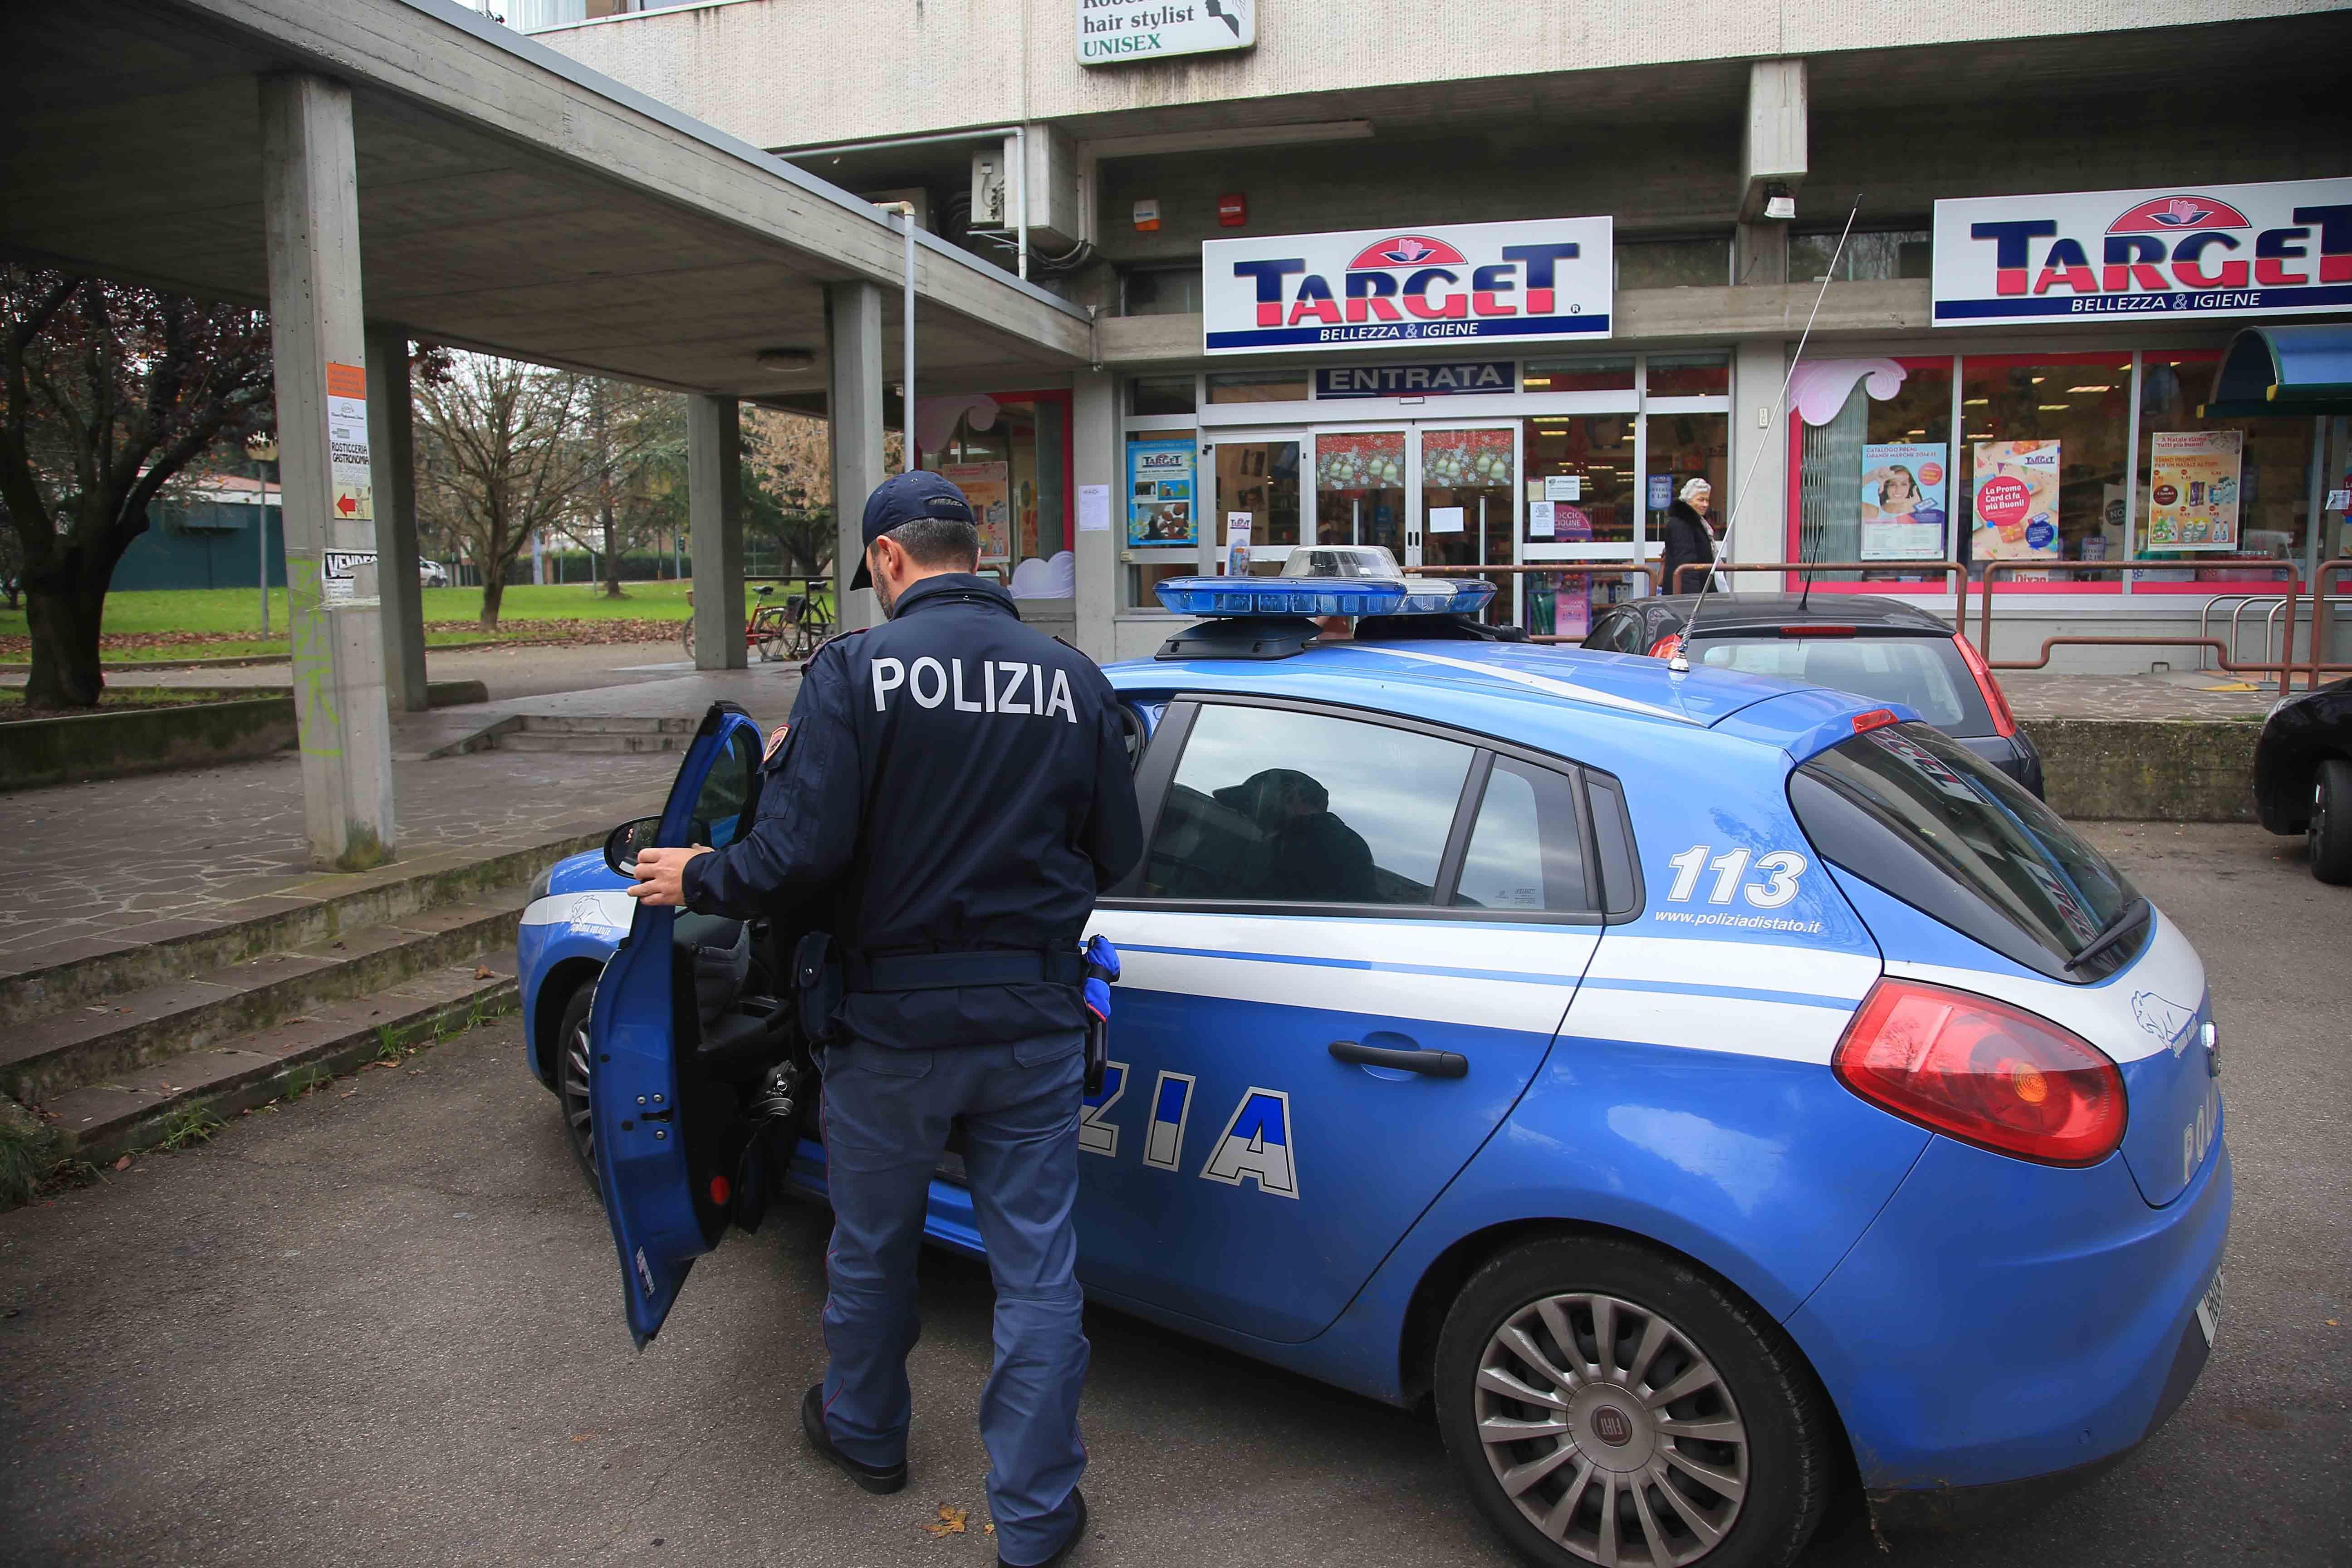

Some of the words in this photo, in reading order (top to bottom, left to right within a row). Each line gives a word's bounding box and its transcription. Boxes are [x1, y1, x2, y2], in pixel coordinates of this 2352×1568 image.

[1083, 14, 1123, 34] hair
[1131, 5, 1194, 29] stylist
[1083, 33, 1162, 57] UNISEX
[1970, 204, 2352, 295] TARGET
[1233, 242, 1580, 327] TARGET
[2071, 296, 2166, 312] BELLEZZA
[2172, 294, 2188, 310] &
[2194, 292, 2261, 308] IGIENE
[1319, 326, 1400, 341] BELLEZZA
[1405, 323, 1417, 338] &
[1422, 322, 1479, 337] IGIENE
[1328, 364, 1504, 391] ENTRATA
[332, 442, 368, 455] ROSTICCERIA
[333, 453, 369, 464] GASTRONOMIA
[1142, 455, 1181, 465] TARGET
[2025, 456, 2055, 464] TARGET
[1985, 493, 2004, 502] Card
[1996, 485, 2022, 493] Promo
[1985, 502, 1999, 512] più
[2015, 573, 2047, 583] Dixan
[871, 656, 1078, 724] POLIZIA
[1666, 844, 1808, 909] 113
[1654, 910, 1822, 934] www.poliziadistato.it
[1600, 1417, 1623, 1435] FIAT
